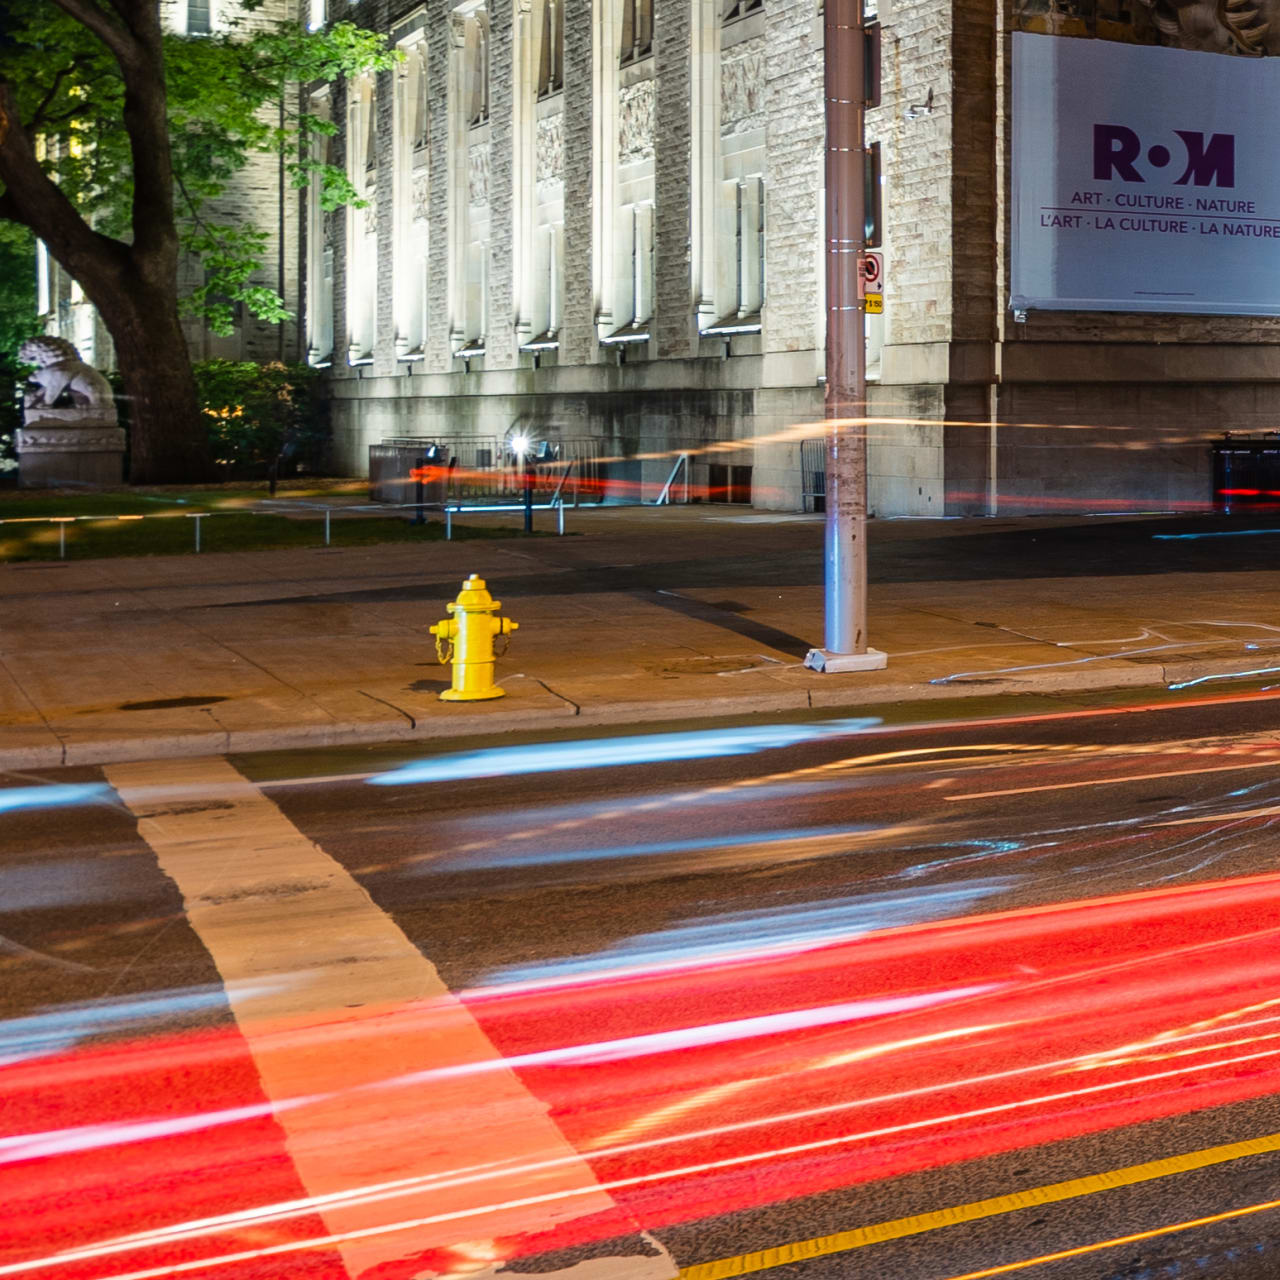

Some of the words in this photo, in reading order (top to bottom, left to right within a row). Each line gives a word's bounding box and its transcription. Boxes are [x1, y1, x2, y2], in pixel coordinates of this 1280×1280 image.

[1071, 191, 1103, 205] ART
[1115, 193, 1184, 210] CULTURE
[1196, 198, 1256, 214] NATURE
[1040, 214, 1083, 228] L'ART
[1095, 217, 1115, 230] LA
[1119, 218, 1188, 234] CULTURE
[1200, 222, 1219, 235] LA
[1223, 223, 1280, 238] NATURE
